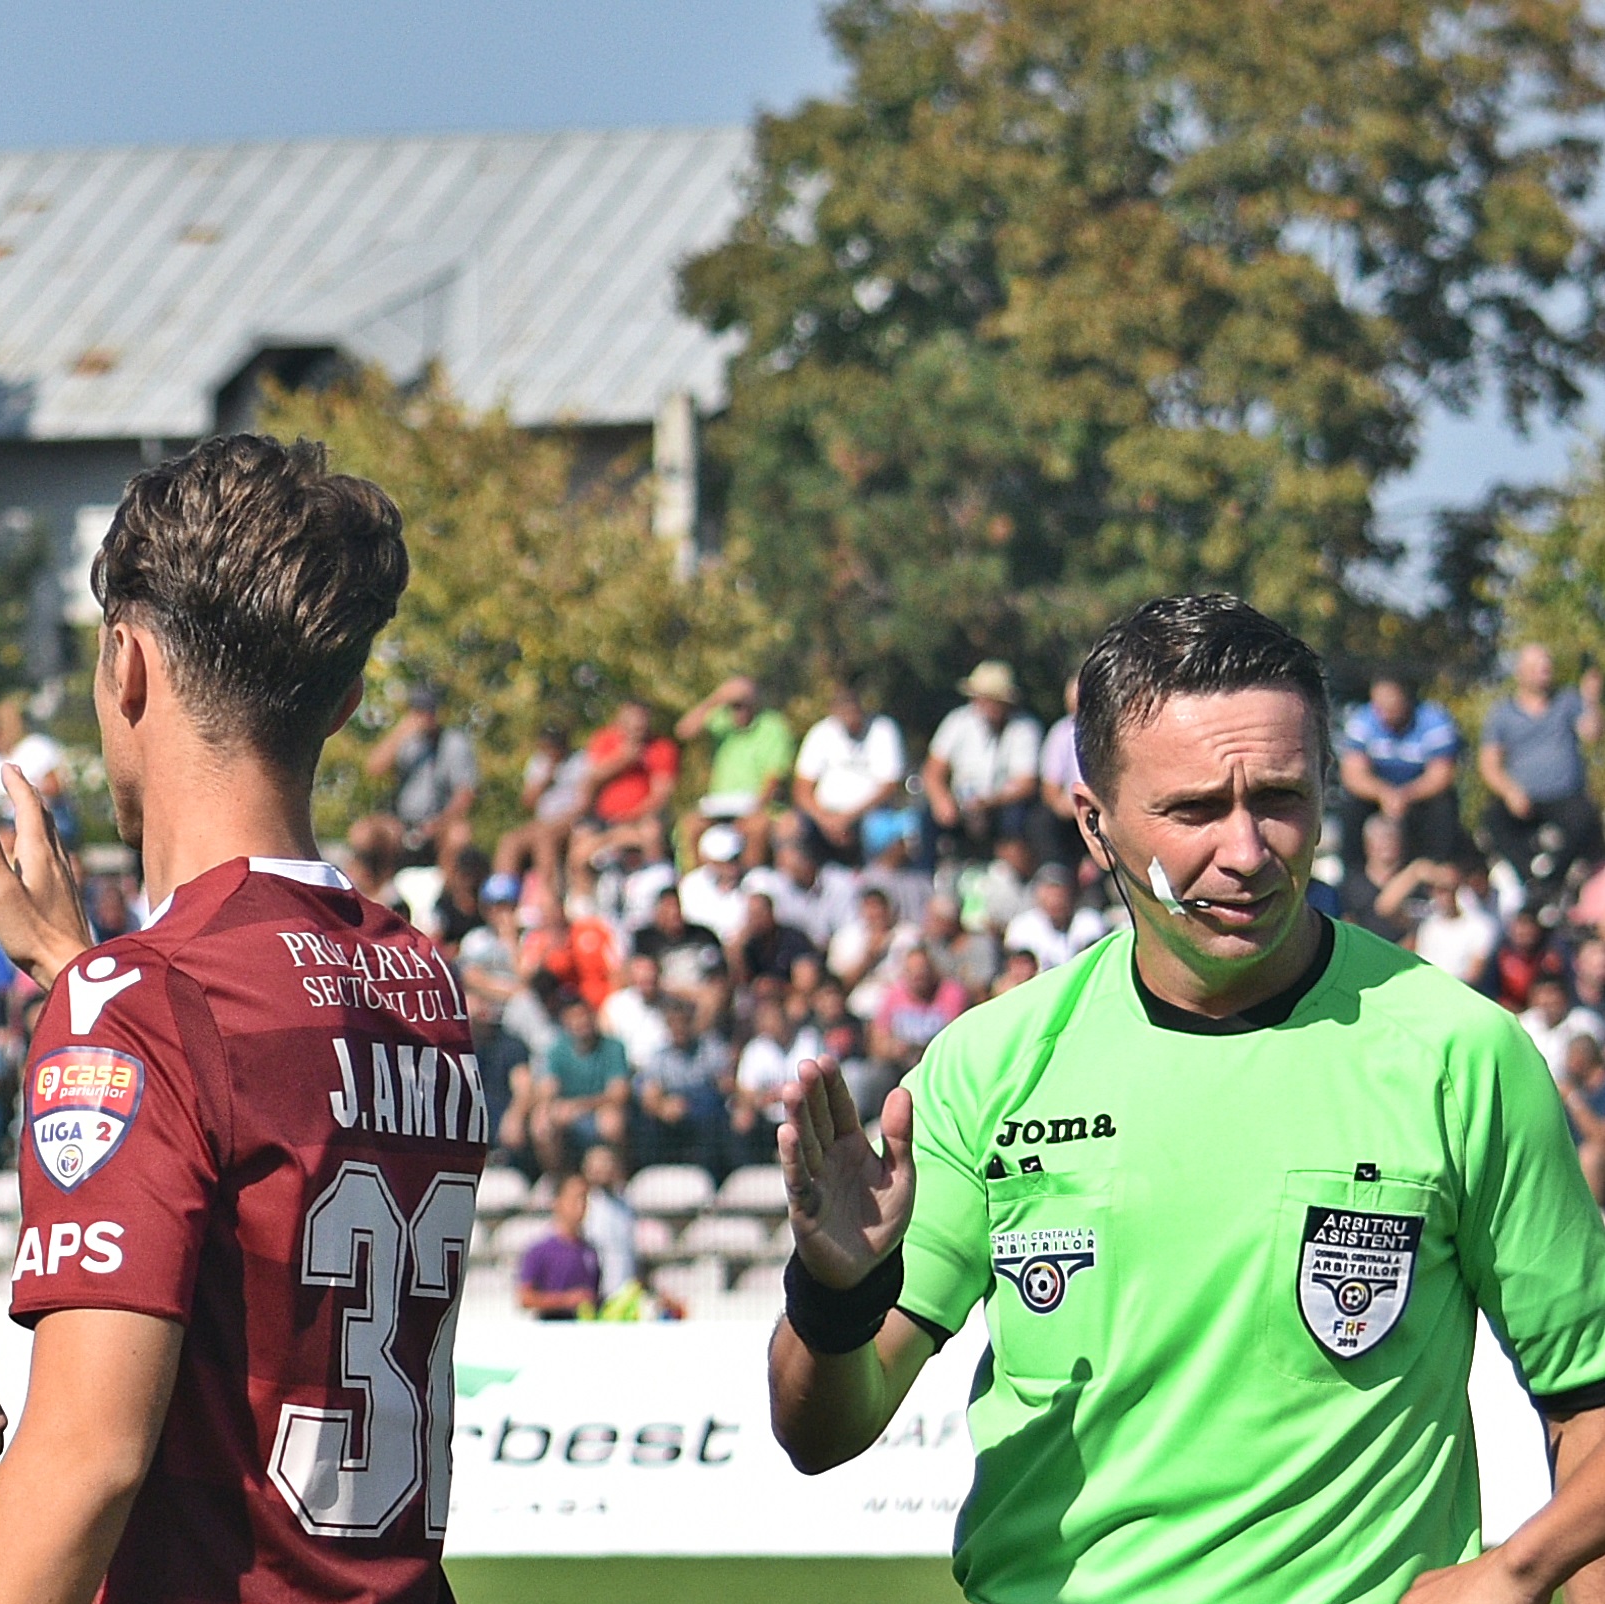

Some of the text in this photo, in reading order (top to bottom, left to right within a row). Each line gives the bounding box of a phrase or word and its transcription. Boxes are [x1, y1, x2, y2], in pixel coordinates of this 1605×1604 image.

[431, 945, 467, 1020] 1
[63, 1066, 131, 1088] casa
[59, 1085, 127, 1099] pariurilor
[41, 1121, 112, 1143] LIGA 2
[996, 1113, 1116, 1147] Joma
[1323, 1213, 1407, 1234] ARBITRU
[991, 1234, 1026, 1243] OMISIA
[991, 1239, 1094, 1255] RBITRILOR
[1313, 1228, 1410, 1249] ASISTENT
[11, 1220, 125, 1282] APS
[1313, 1260, 1399, 1276] ARBITRILOR
[1333, 1320, 1367, 1336] FRF
[266, 1160, 481, 1539] 32
